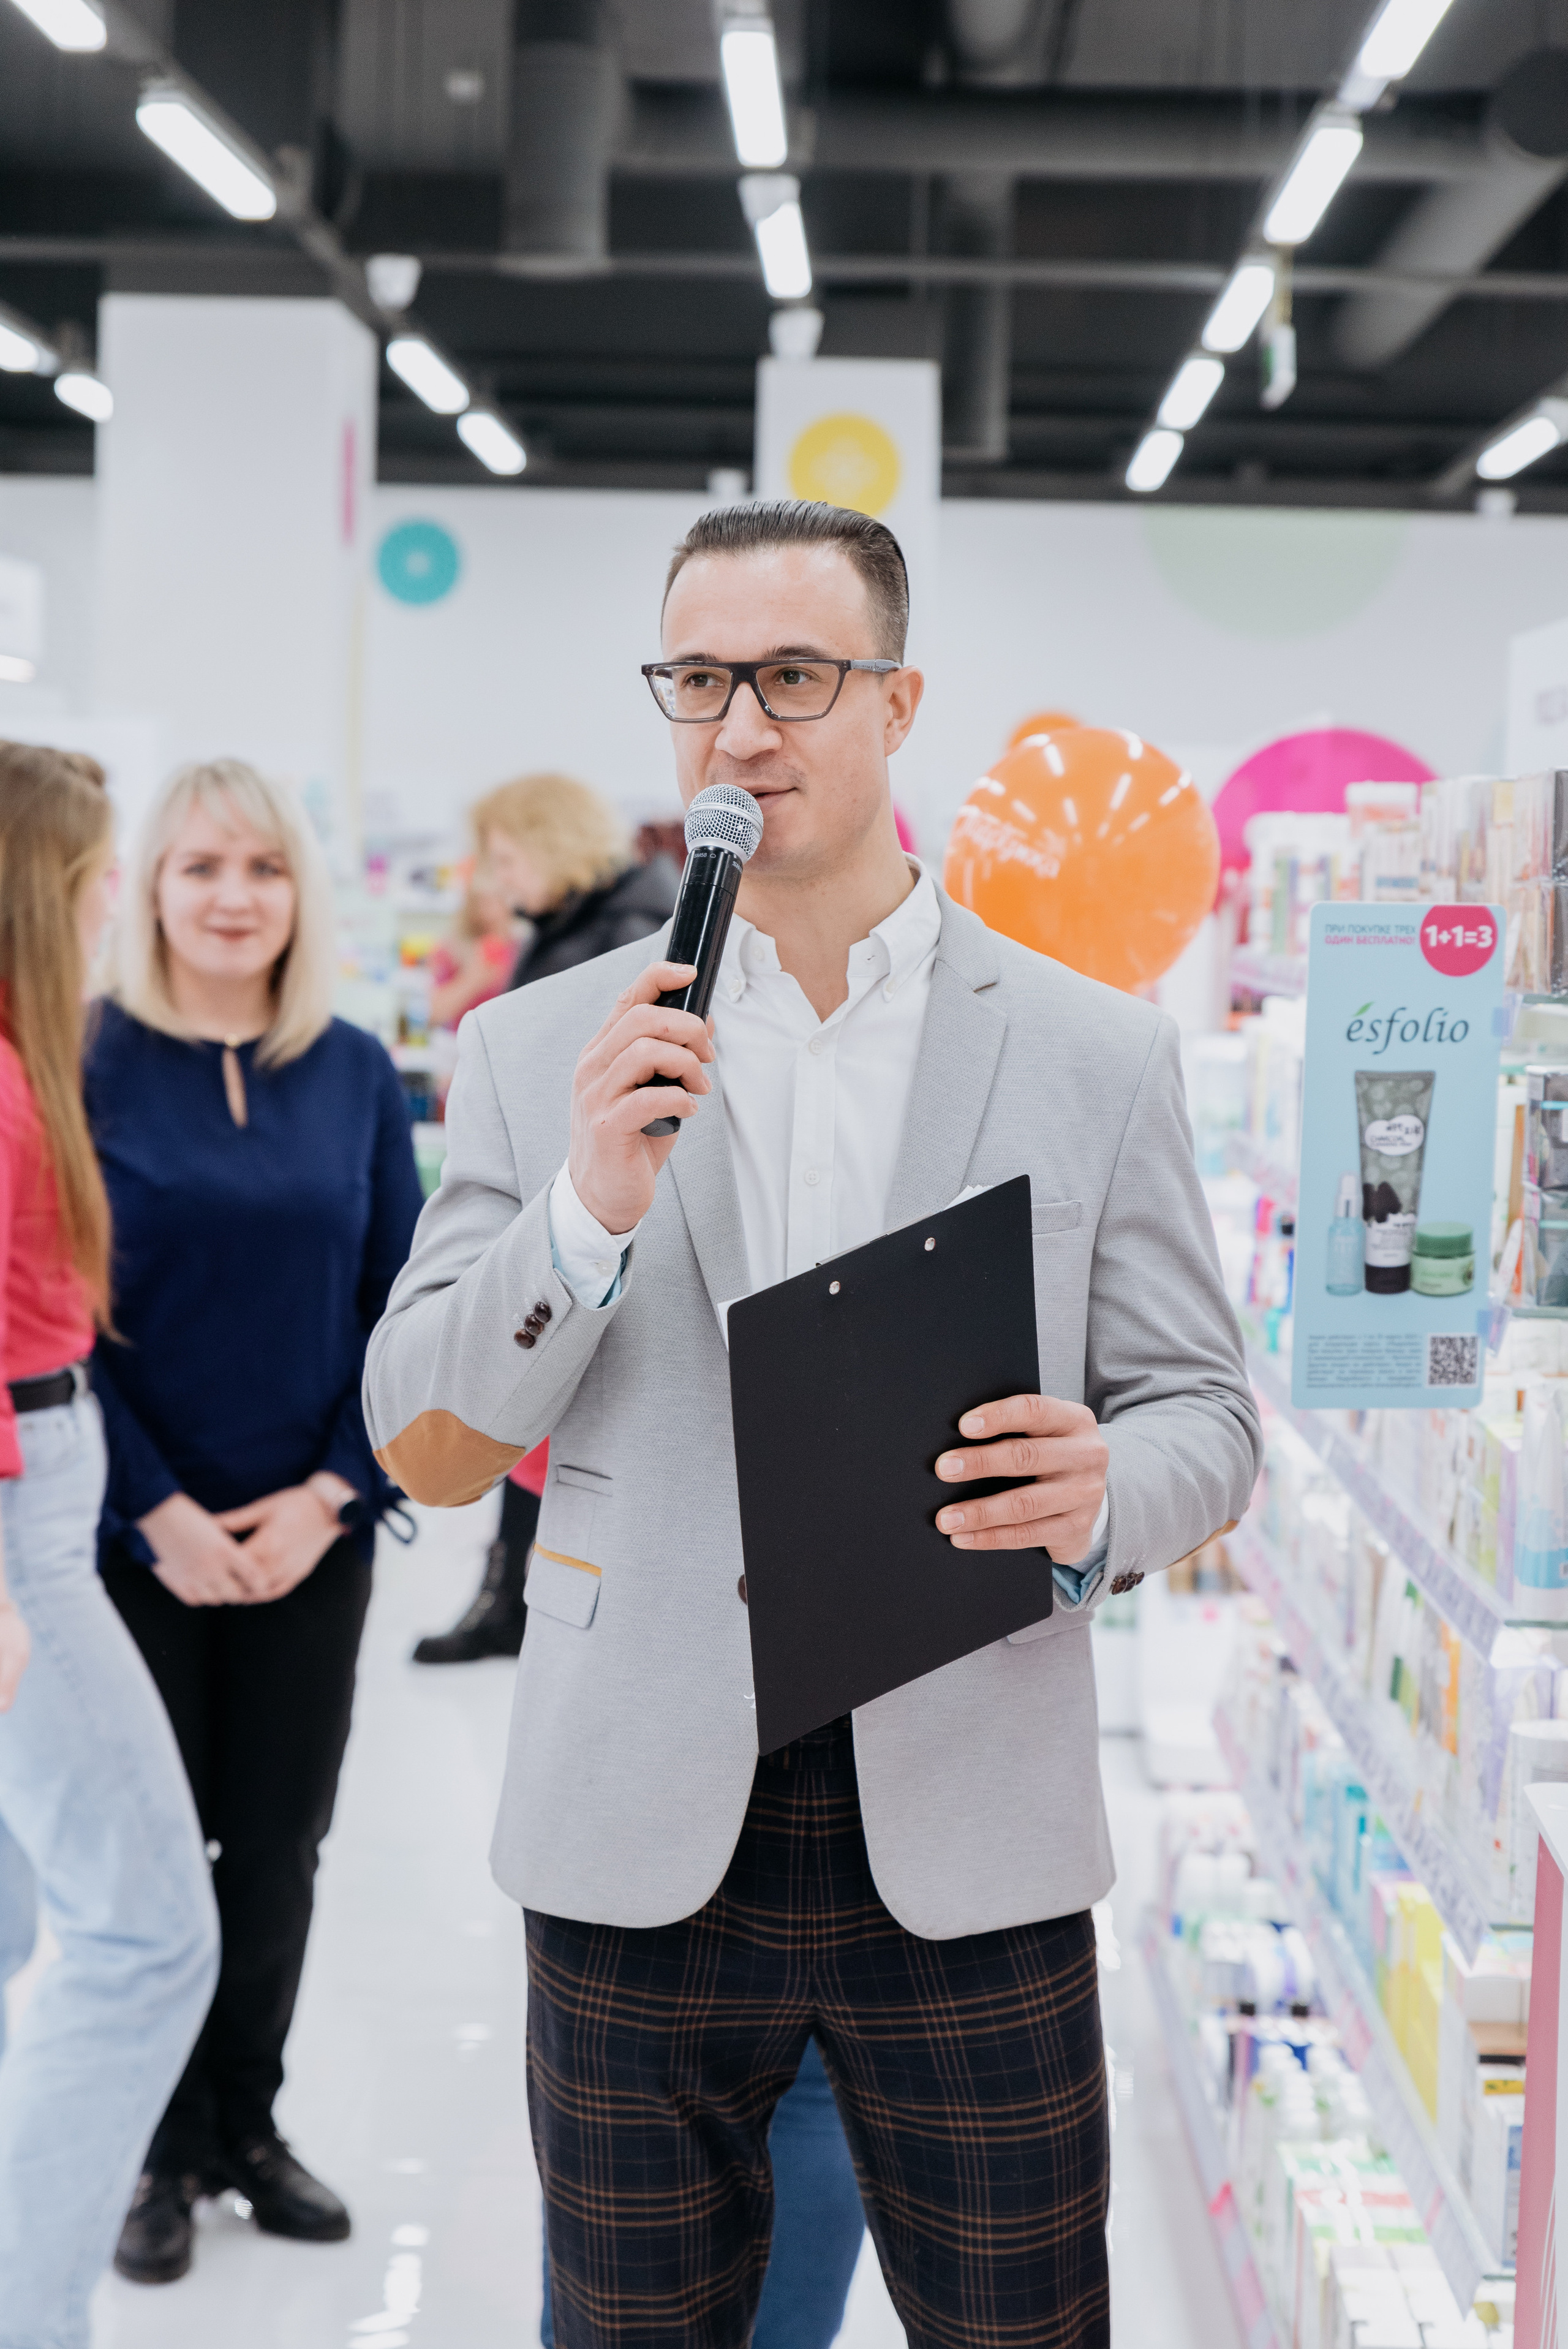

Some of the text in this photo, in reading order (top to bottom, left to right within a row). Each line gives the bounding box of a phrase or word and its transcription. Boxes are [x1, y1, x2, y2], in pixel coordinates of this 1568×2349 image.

[1325, 924, 1345, 933] ПРИ
[1348, 924, 1390, 934] ПОКУПКЕ
[1325, 935, 1354, 945] ОДИН
[1425, 925, 1493, 948] 1+1=3
